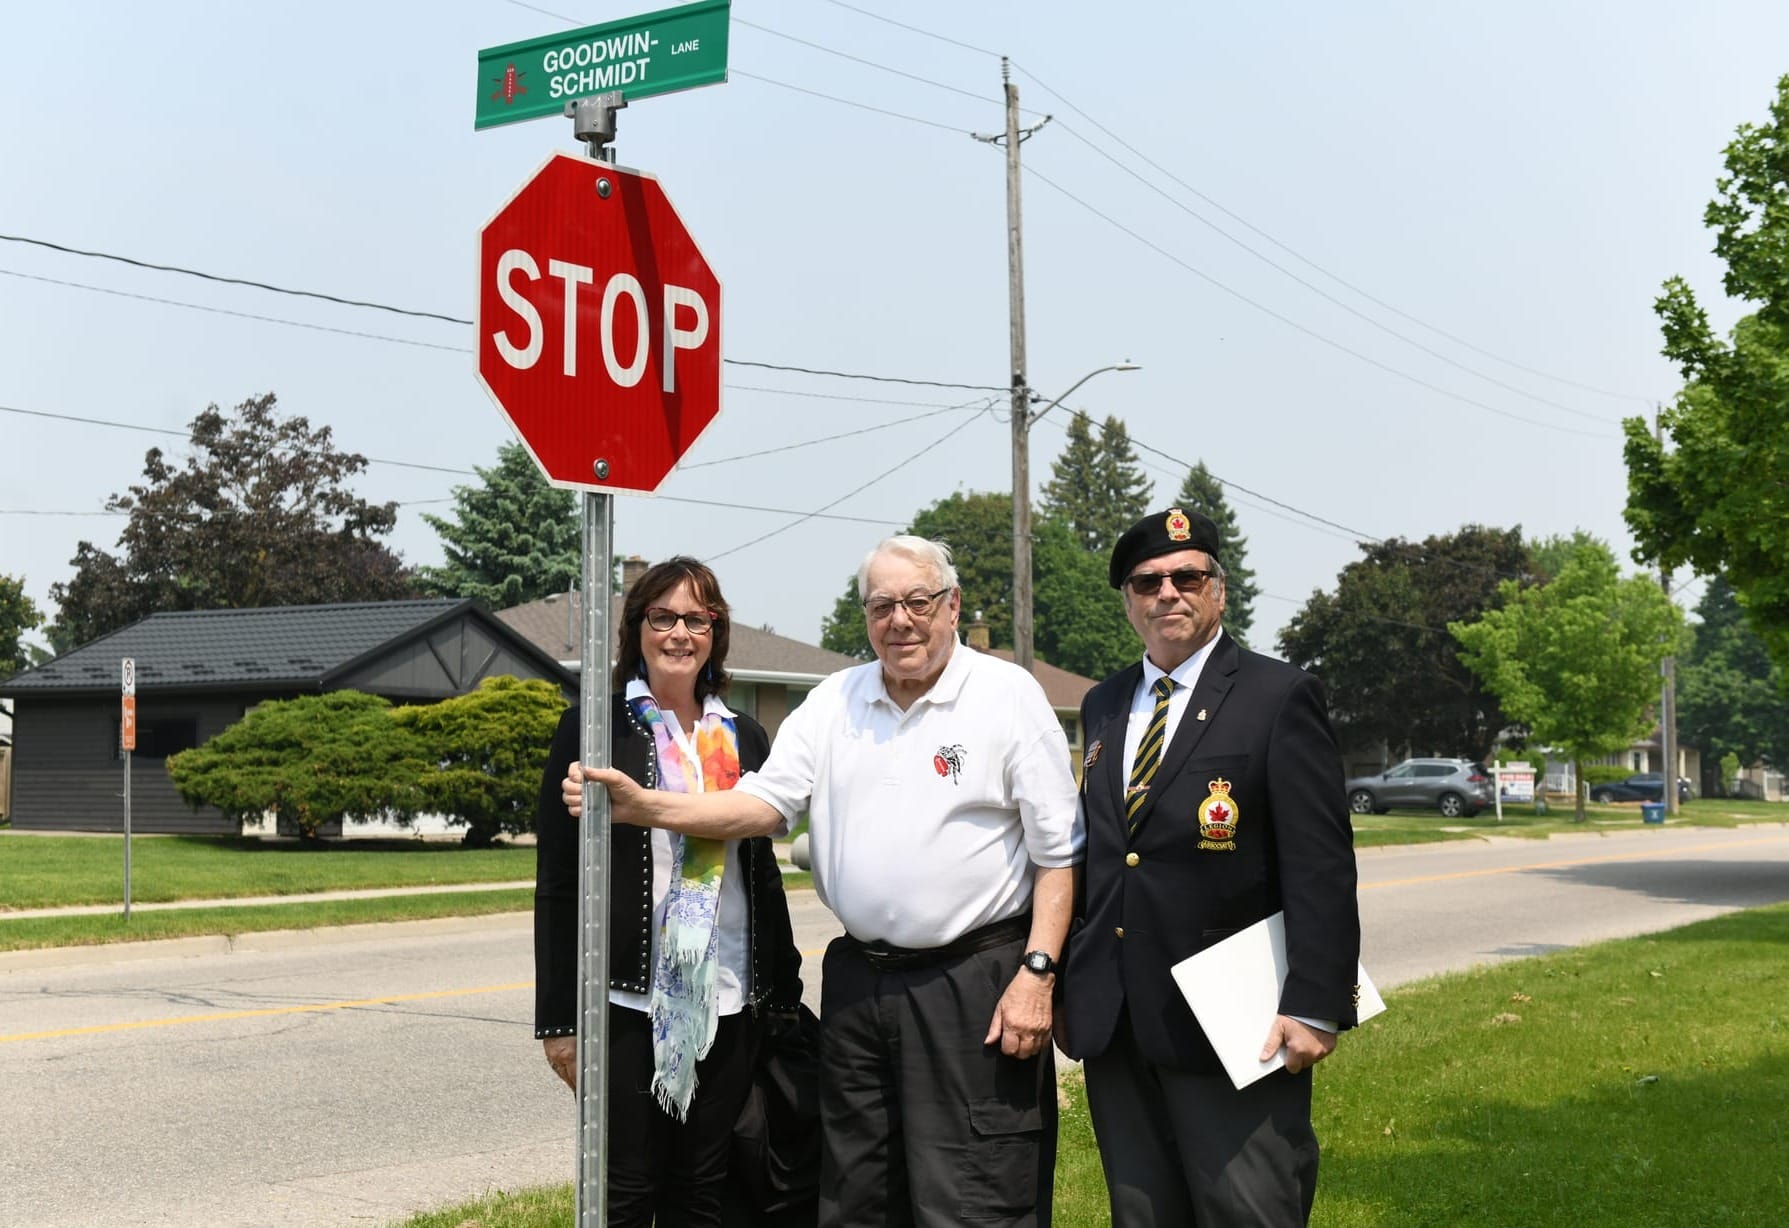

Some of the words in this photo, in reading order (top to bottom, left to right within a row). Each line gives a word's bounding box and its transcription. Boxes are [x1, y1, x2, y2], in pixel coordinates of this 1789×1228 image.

[543, 31, 659, 73] GOODWIN-
[671, 39, 700, 56] LANE
[549, 58, 650, 98] SCHMIDT
[493, 249, 709, 393] STOP
